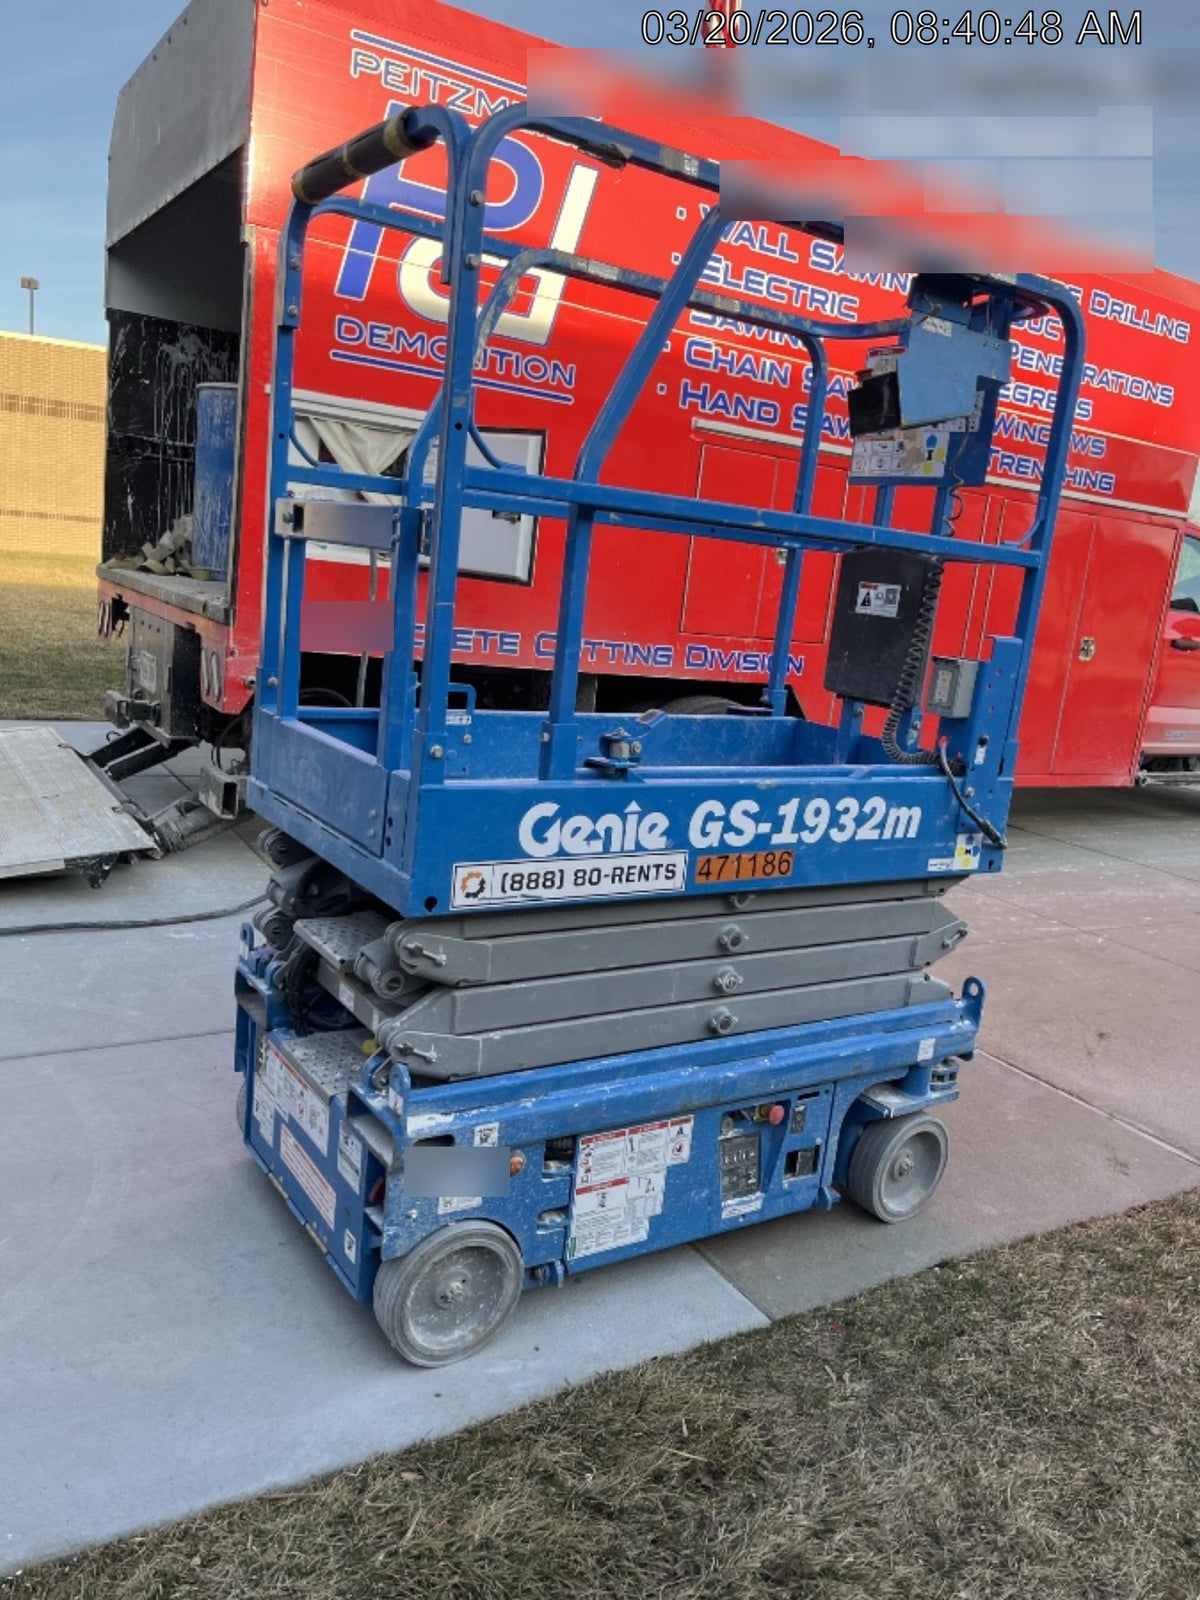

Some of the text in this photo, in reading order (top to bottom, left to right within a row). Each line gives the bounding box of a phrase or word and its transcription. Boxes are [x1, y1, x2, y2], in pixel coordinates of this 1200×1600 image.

[700, 253, 859, 321] ELECTRIC
[1089, 289, 1190, 343] DRILLING
[335, 314, 576, 388] DEMOITION
[684, 337, 791, 388] CHAIN
[679, 378, 780, 426] HAND
[992, 412, 1107, 458] WINDWS
[533, 630, 674, 668] CTTING
[518, 796, 922, 859] Genie GS-1932m
[501, 862, 677, 894] (888) 80-RENTS
[697, 850, 792, 881] 471186
